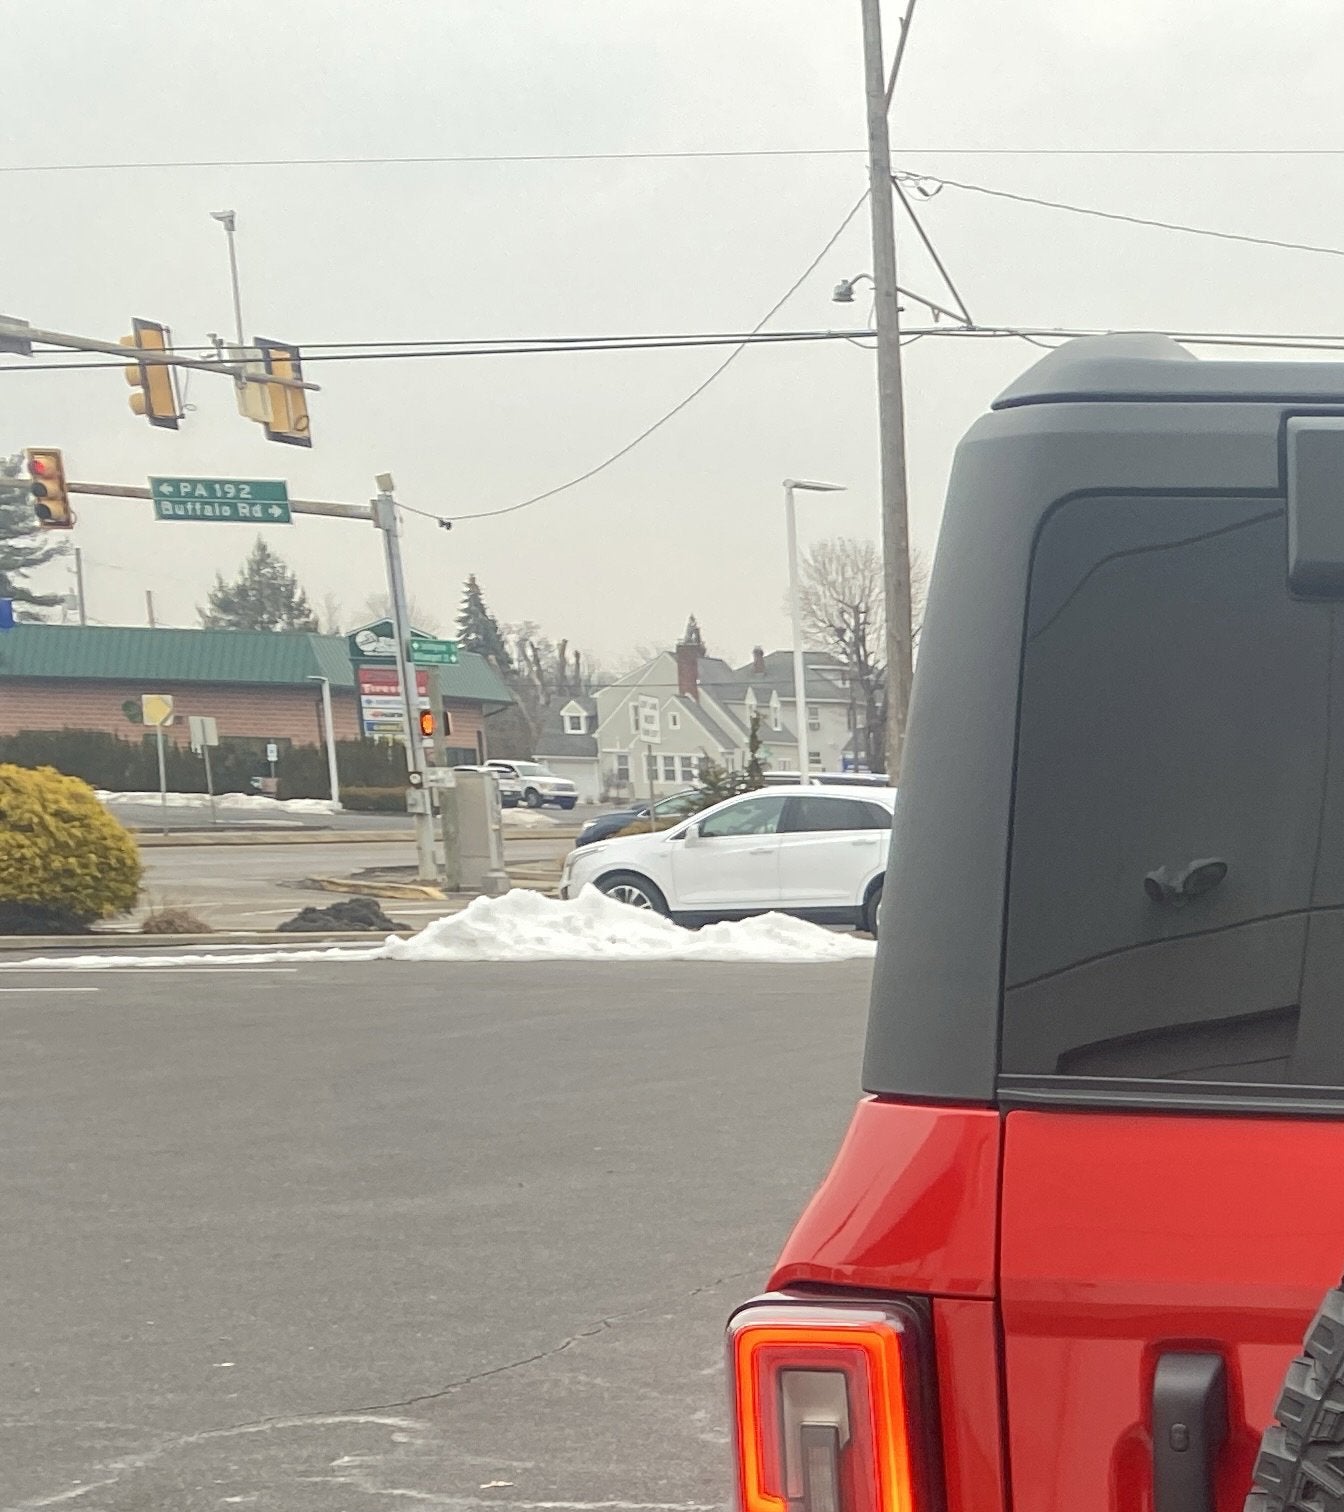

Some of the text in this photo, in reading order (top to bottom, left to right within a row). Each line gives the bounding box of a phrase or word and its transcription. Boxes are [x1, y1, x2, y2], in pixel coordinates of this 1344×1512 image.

[179, 482, 252, 498] PA 192
[160, 501, 262, 517] Buffalo Rd
